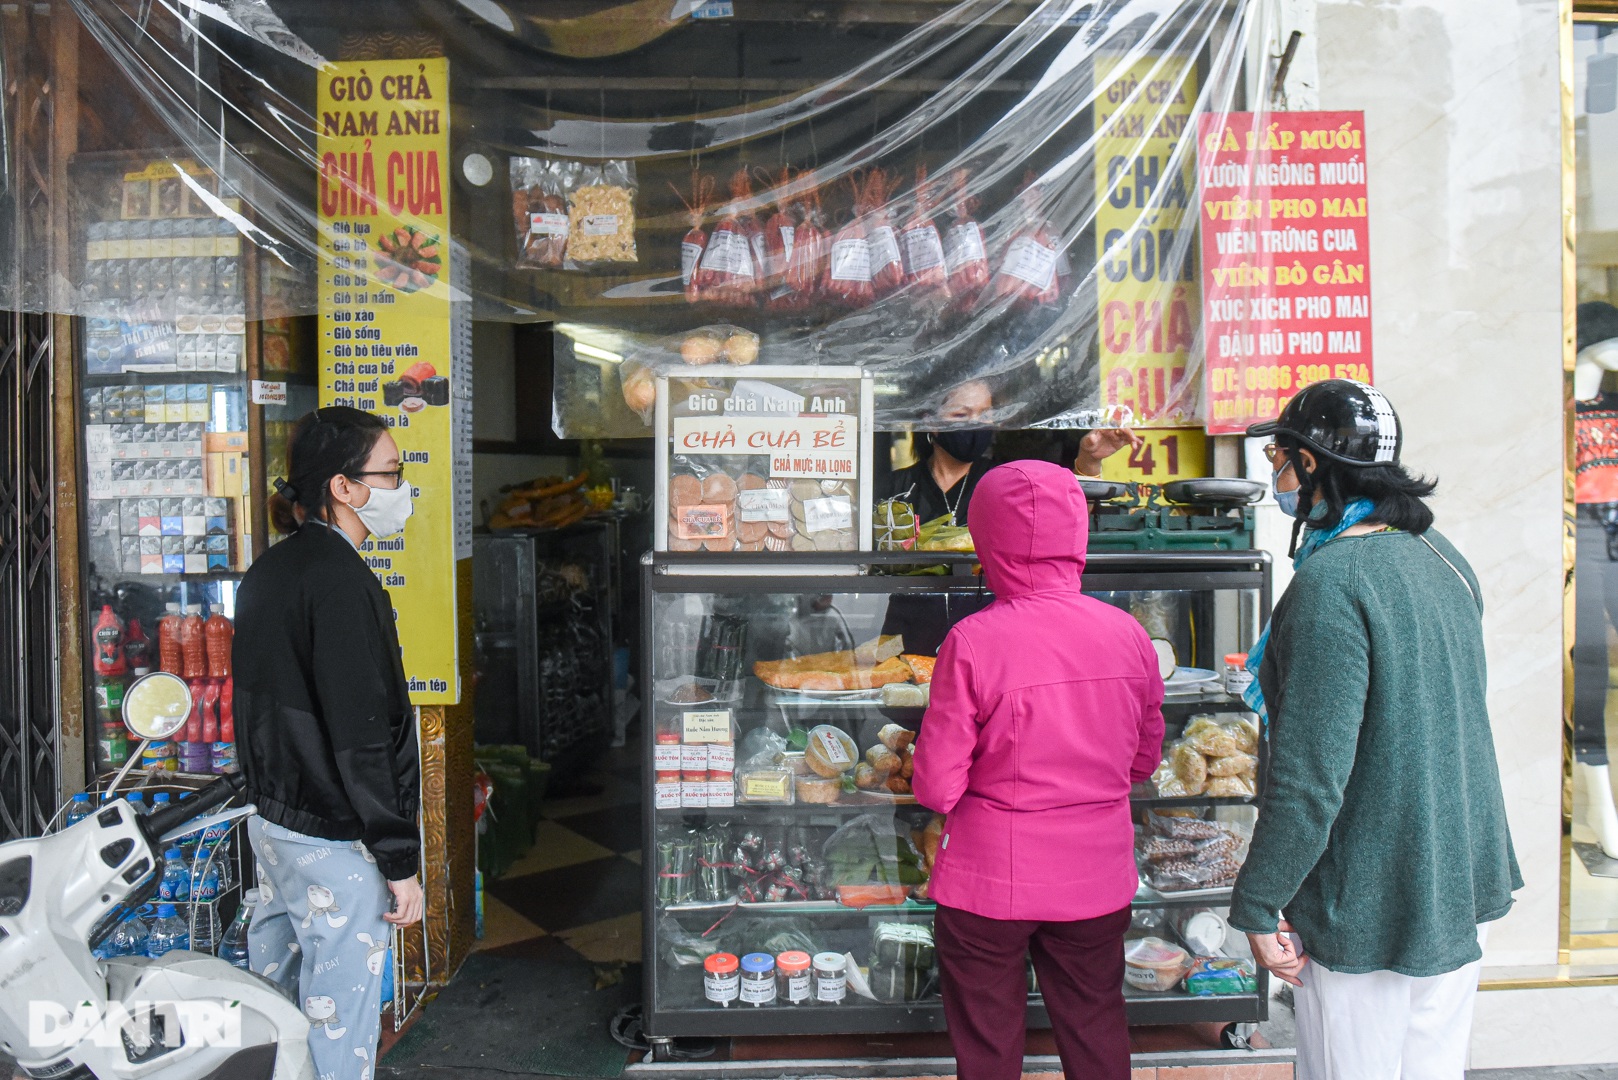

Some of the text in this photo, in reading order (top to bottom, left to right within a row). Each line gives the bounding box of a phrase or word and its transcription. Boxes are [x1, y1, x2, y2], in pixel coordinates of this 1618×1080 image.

[330, 63, 432, 101] GIÒ CHẢ
[1107, 70, 1186, 104] GIÒ CHẢ
[323, 109, 440, 136] NAM ANH
[1101, 113, 1145, 138] NAM
[1205, 127, 1240, 152] GÀ
[1300, 121, 1362, 150] MUỐI
[321, 139, 442, 217] CHẢ CUA
[1107, 142, 1189, 210] CHẢ
[1204, 154, 1365, 188] LƯỜN NGỖNG MUỐI
[1204, 195, 1367, 221] VIÊN PHO MAI
[333, 221, 371, 236] Giò lụa
[1216, 225, 1358, 254] VIÊN TRỨNG CUA
[1103, 215, 1194, 283] CỐM
[333, 274, 351, 287] Giò
[1211, 259, 1365, 287] VIÊN BÒ GÂN
[333, 289, 395, 304] Giò tai nấm
[1210, 293, 1369, 322] XÚC XÍCH PHO MAI
[334, 309, 375, 322] Giò xào
[1103, 286, 1194, 354] CHẢ
[334, 325, 381, 340] Giò sống
[1219, 328, 1361, 362] ĐẬU HŨ PHO MAI
[334, 343, 418, 357] Giò bò tiêu viên
[334, 359, 395, 374] Chả cua bể
[1212, 367, 1240, 393] ĐT:
[1245, 365, 1292, 391] 0986
[1296, 364, 1331, 390] 399
[334, 377, 379, 393] Chả quế
[1107, 366, 1196, 421] CUA
[334, 396, 375, 412] Chả lợn
[688, 392, 846, 413] Giò chả Nam Anh
[1257, 393, 1276, 418] ÉP
[398, 415, 409, 427] là
[683, 420, 846, 449] CHẢ CUA BỂ
[403, 450, 429, 464] Long
[774, 453, 791, 472] CHẢ
[793, 457, 813, 474] MỰC
[815, 459, 828, 475] HẠ
[1128, 435, 1179, 475] 41
[377, 536, 404, 551] muối
[386, 572, 405, 586] sản
[430, 679, 447, 692] tép
[296, 846, 332, 867] RAINY DAY
[325, 956, 340, 971] DAY
